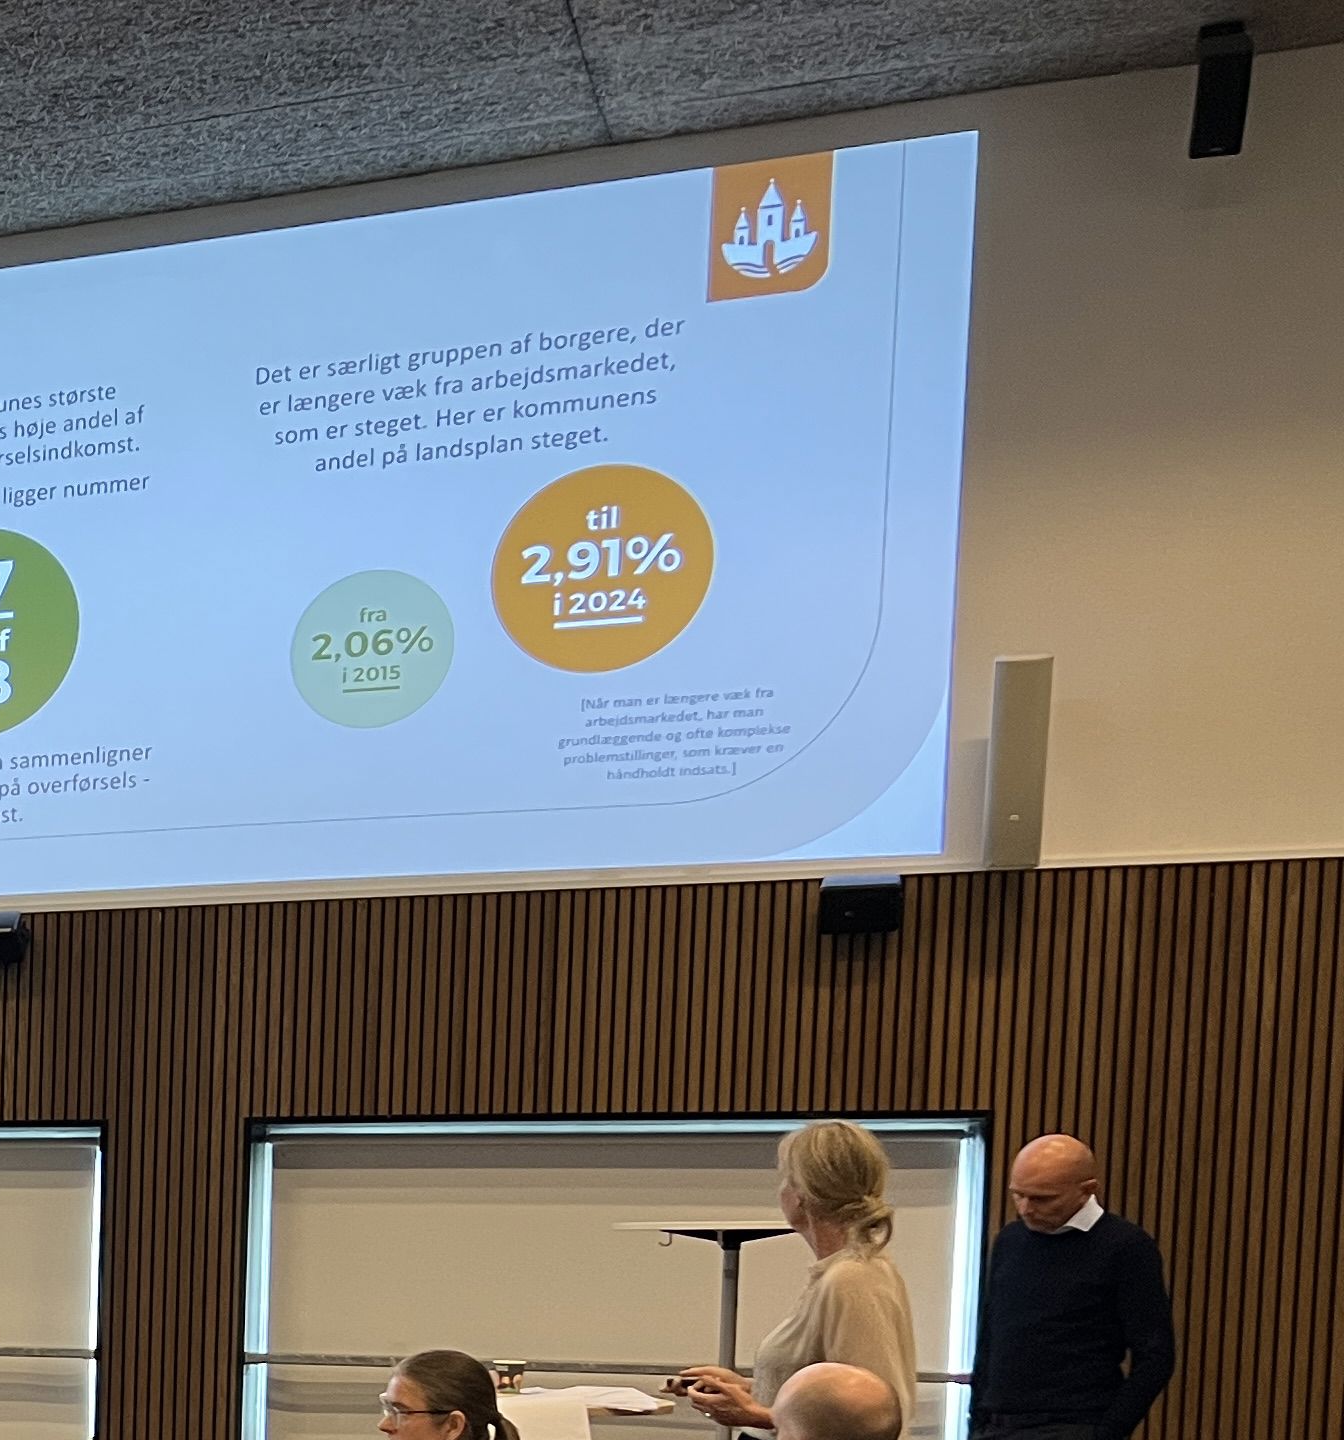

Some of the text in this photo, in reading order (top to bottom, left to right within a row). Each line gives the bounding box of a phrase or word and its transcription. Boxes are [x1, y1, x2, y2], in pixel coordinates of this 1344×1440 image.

[256, 318, 685, 385] Det er særligt gruppen af borgere, der
[49, 386, 116, 407] største
[259, 352, 675, 415] er længere væk fra arbejdsmarkedet,
[14, 418, 56, 440] høje
[63, 408, 118, 432] andel
[125, 404, 145, 425] af
[275, 389, 656, 445] som er steget. Her er kommunens
[315, 427, 608, 471] andel på landsplan steget.
[3, 485, 56, 508] ligger
[64, 475, 149, 499] nummer
[586, 506, 618, 532] til
[521, 533, 681, 586] 2,91%
[359, 607, 387, 623] fra
[553, 588, 646, 616] i 2024
[312, 625, 434, 662] 2,06%
[342, 665, 401, 683] i 2015
[10, 745, 152, 769] sammenligner
[28, 772, 136, 794] overførsels
